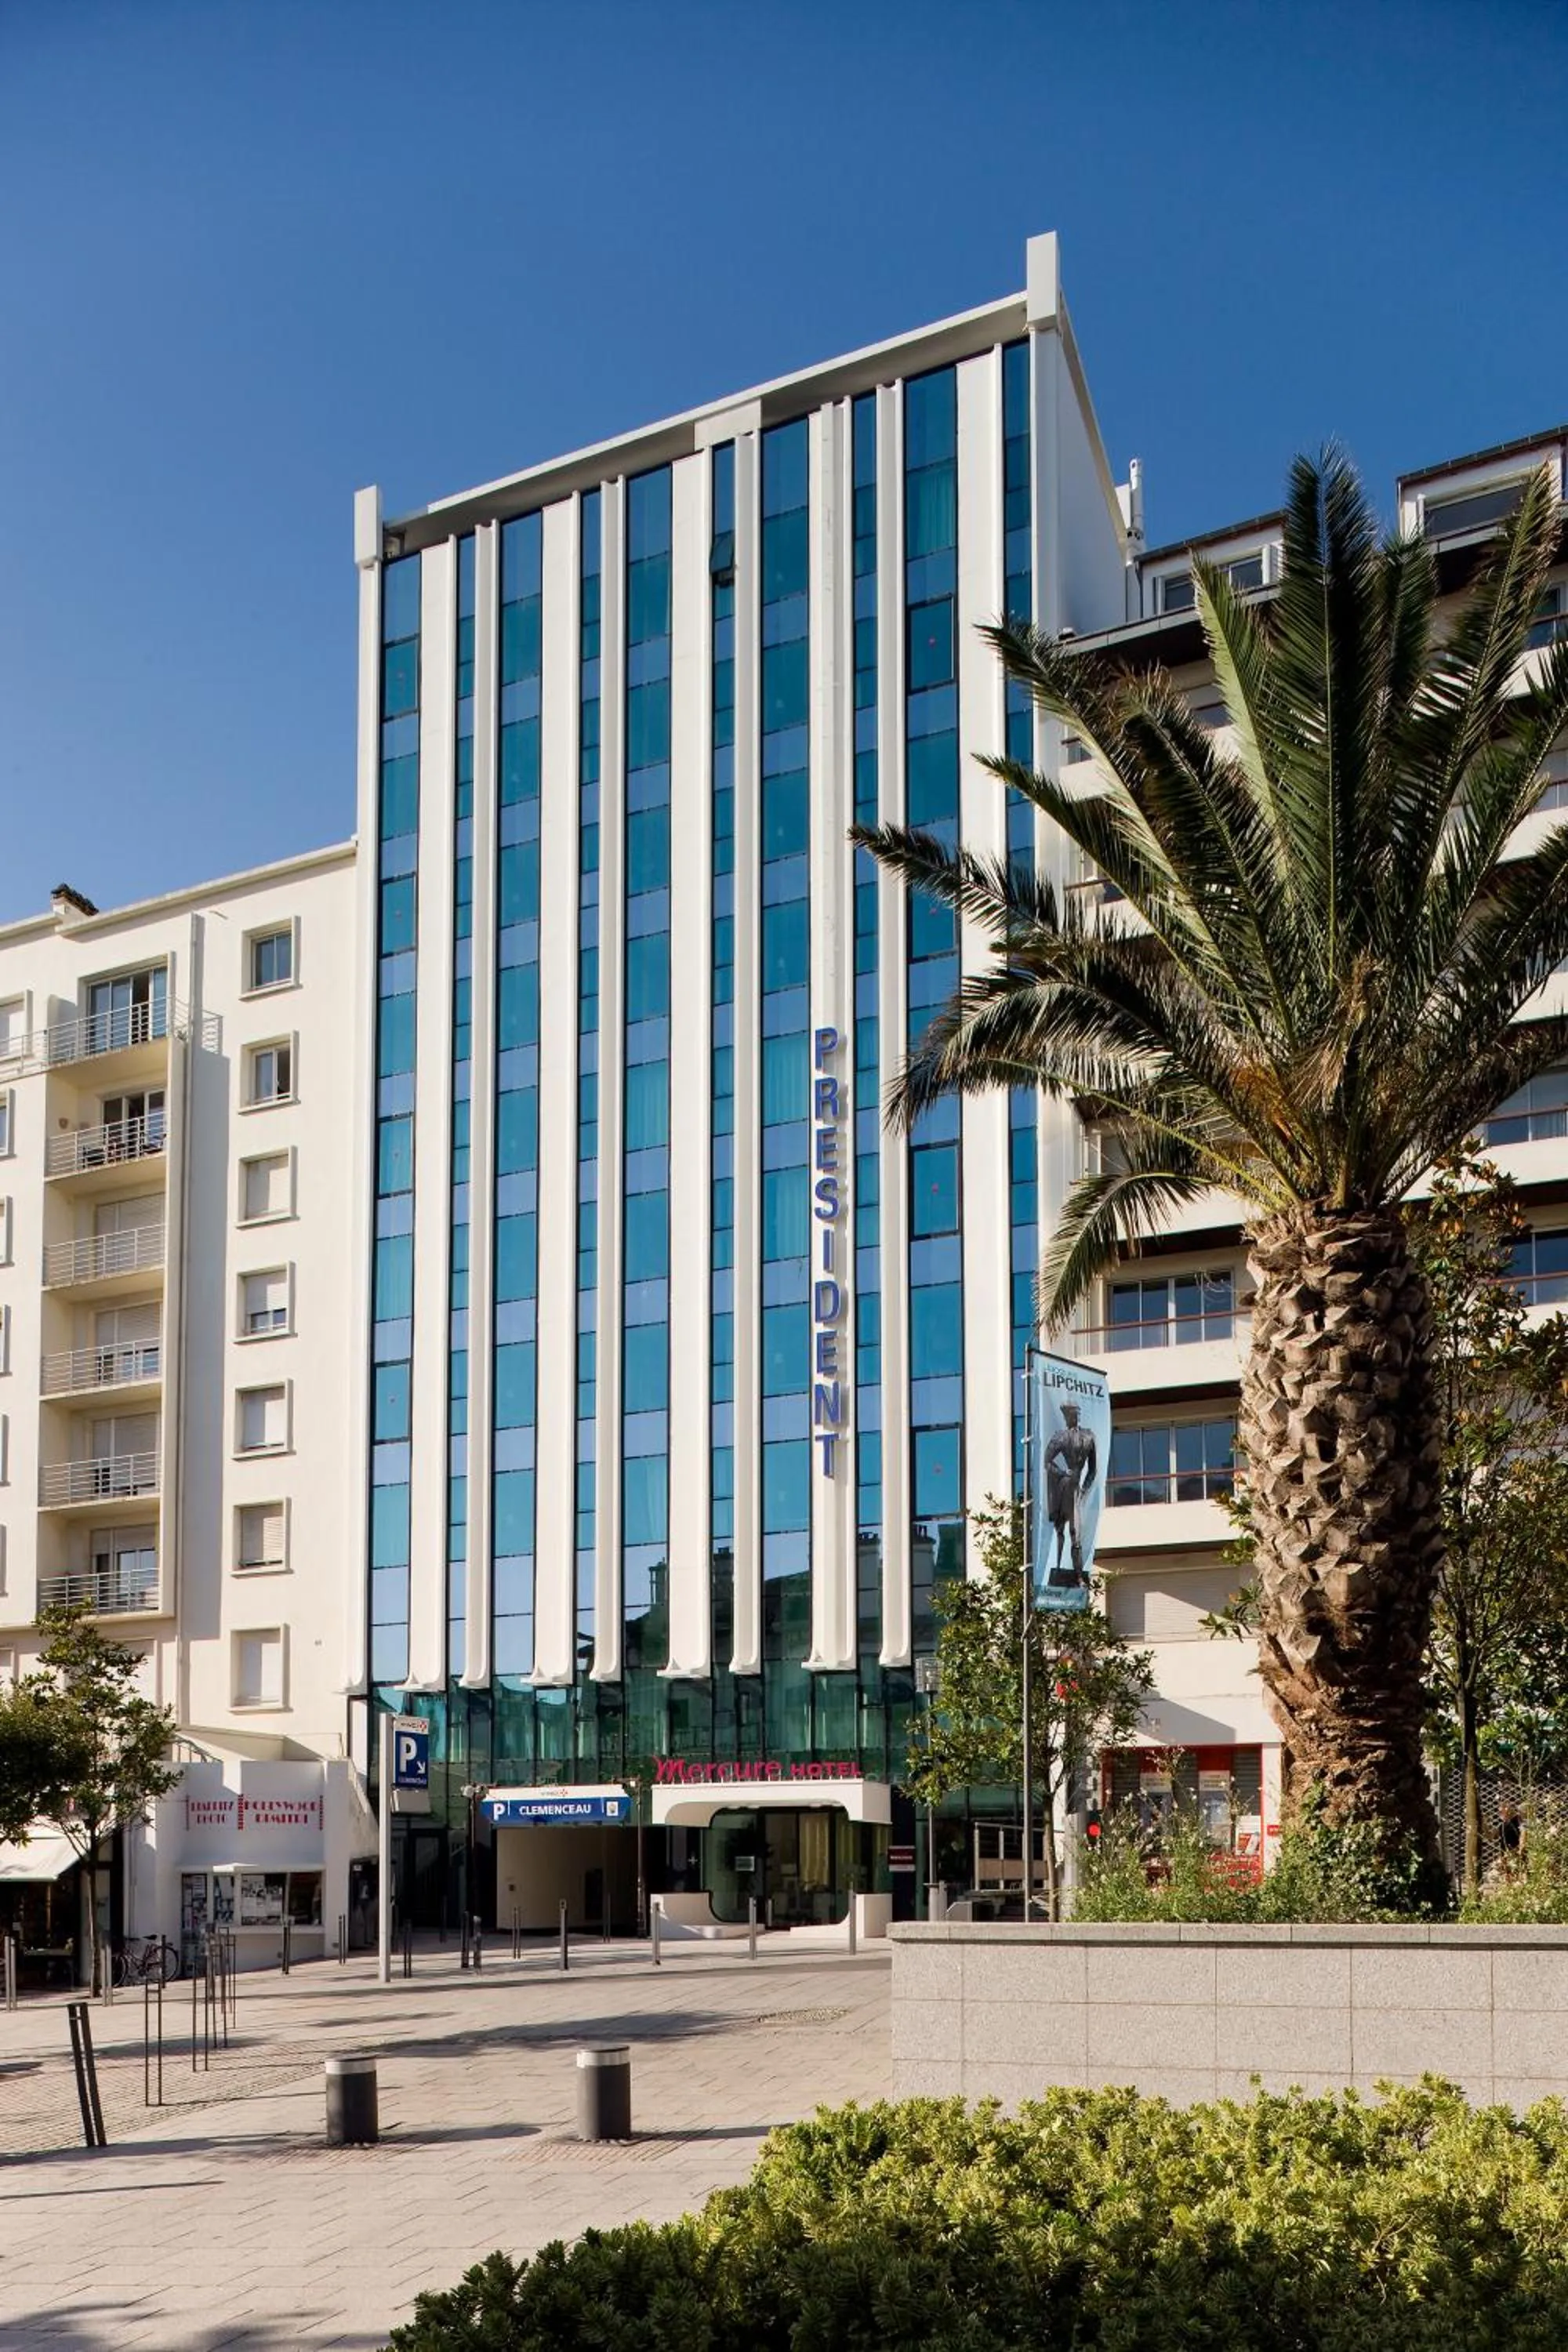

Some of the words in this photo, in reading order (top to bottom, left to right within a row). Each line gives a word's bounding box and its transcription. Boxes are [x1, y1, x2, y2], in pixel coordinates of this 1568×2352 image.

[814, 1027, 840, 1480] PRESIDENT
[1044, 1371, 1105, 1398] LIPCHITZ
[399, 1736, 417, 1773] P
[652, 1755, 782, 1783] Mercure
[789, 1762, 862, 1777] HOTEL
[493, 1802, 506, 1820] P
[519, 1804, 591, 1816] CLEMENCEAU
